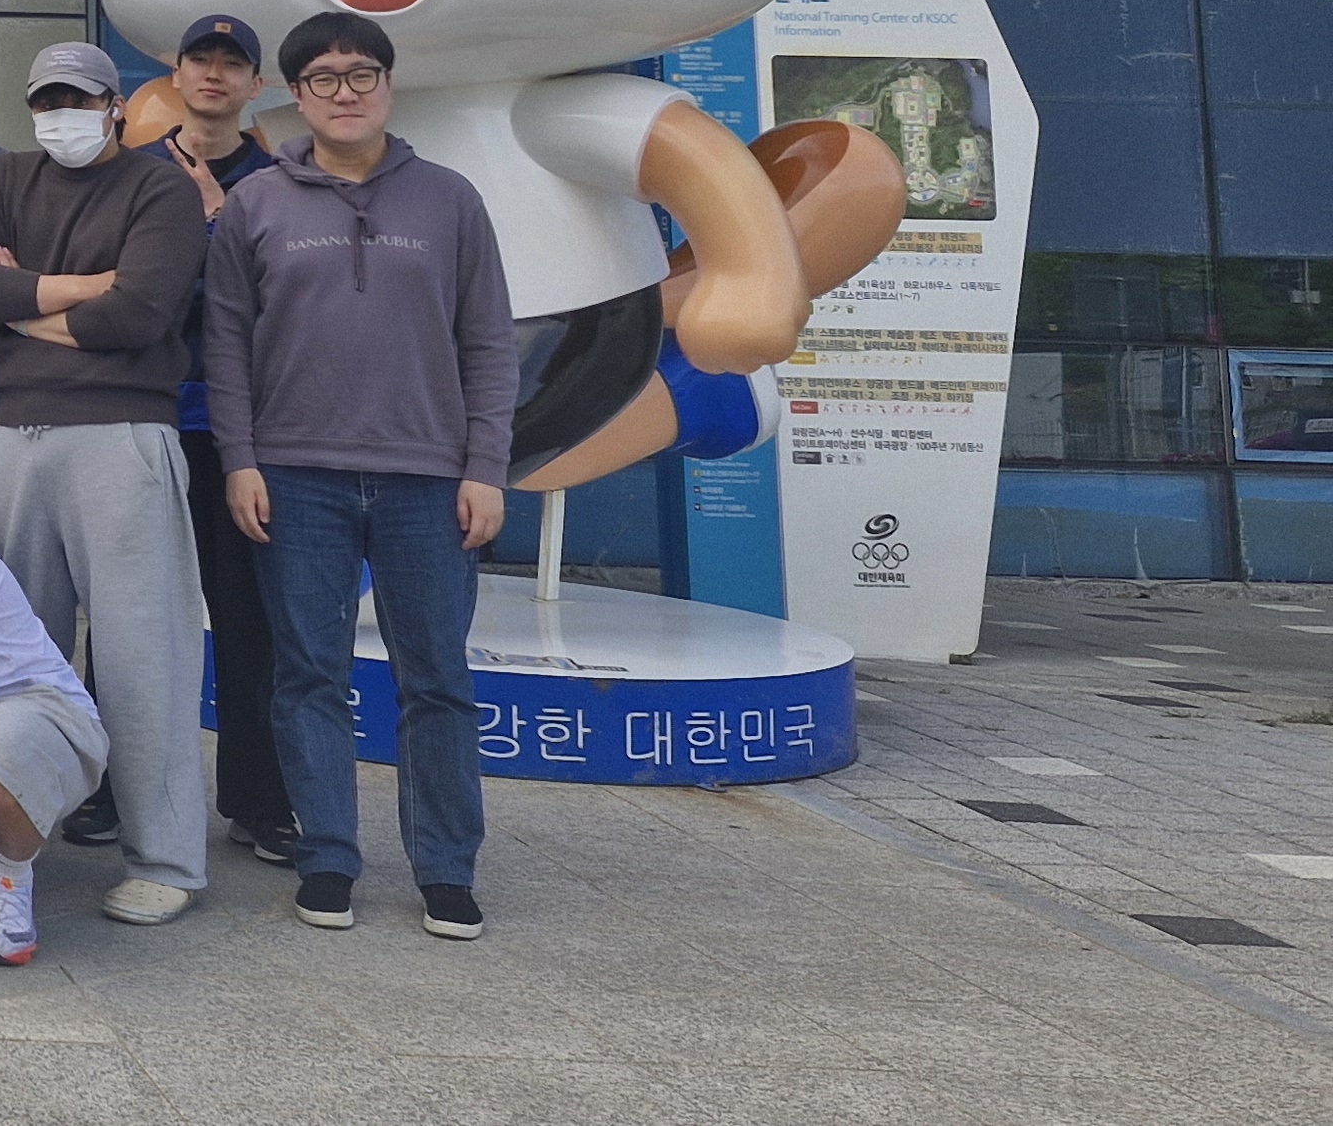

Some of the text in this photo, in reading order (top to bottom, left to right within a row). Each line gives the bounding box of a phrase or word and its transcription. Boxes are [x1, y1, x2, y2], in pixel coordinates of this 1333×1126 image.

[774, 11, 957, 25] National Training Center of KSOC
[775, 26, 841, 37] Information
[286, 235, 351, 252] BANANA
[857, 571, 905, 583] 대한체육회
[474, 703, 816, 766] 강한 대한민국
